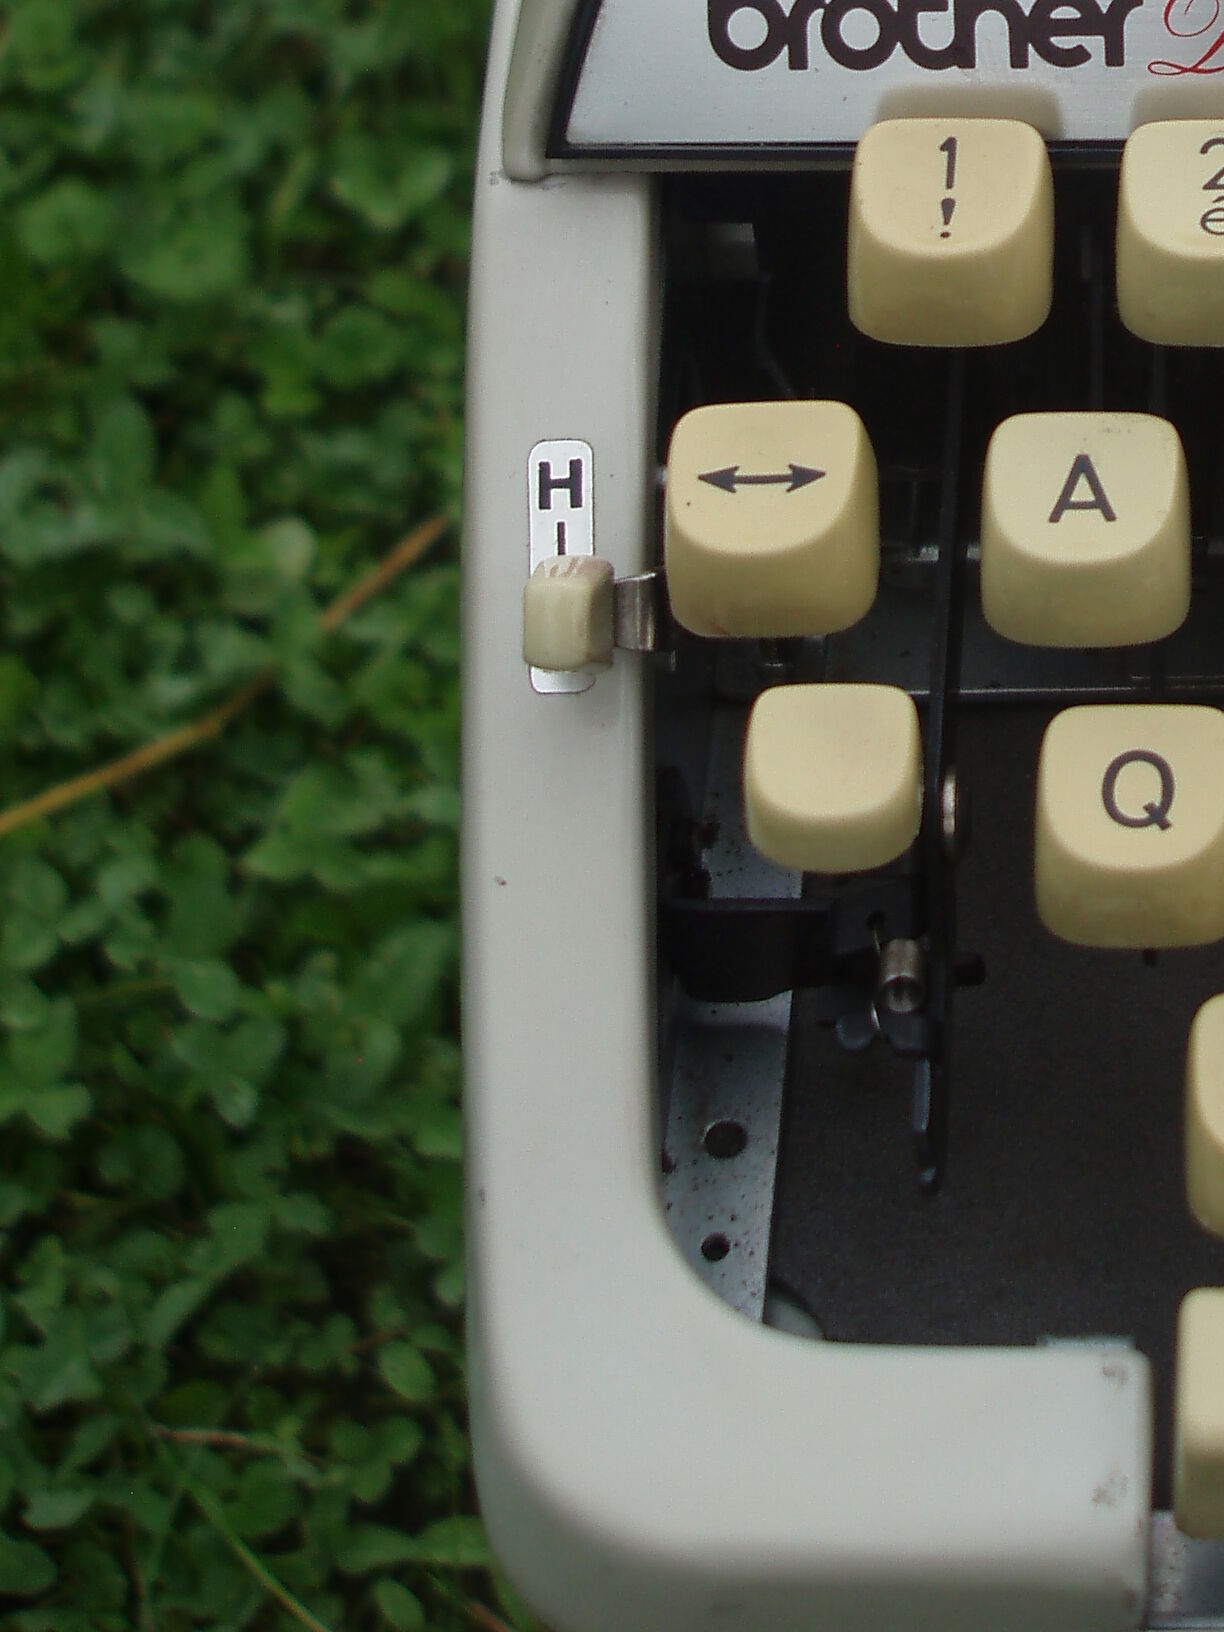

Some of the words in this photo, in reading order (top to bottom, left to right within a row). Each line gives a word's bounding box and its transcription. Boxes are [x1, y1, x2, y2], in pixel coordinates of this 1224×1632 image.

[939, 136, 958, 190] 1
[538, 458, 583, 511] H
[1048, 453, 1118, 524] A
[1101, 749, 1175, 832] Q
